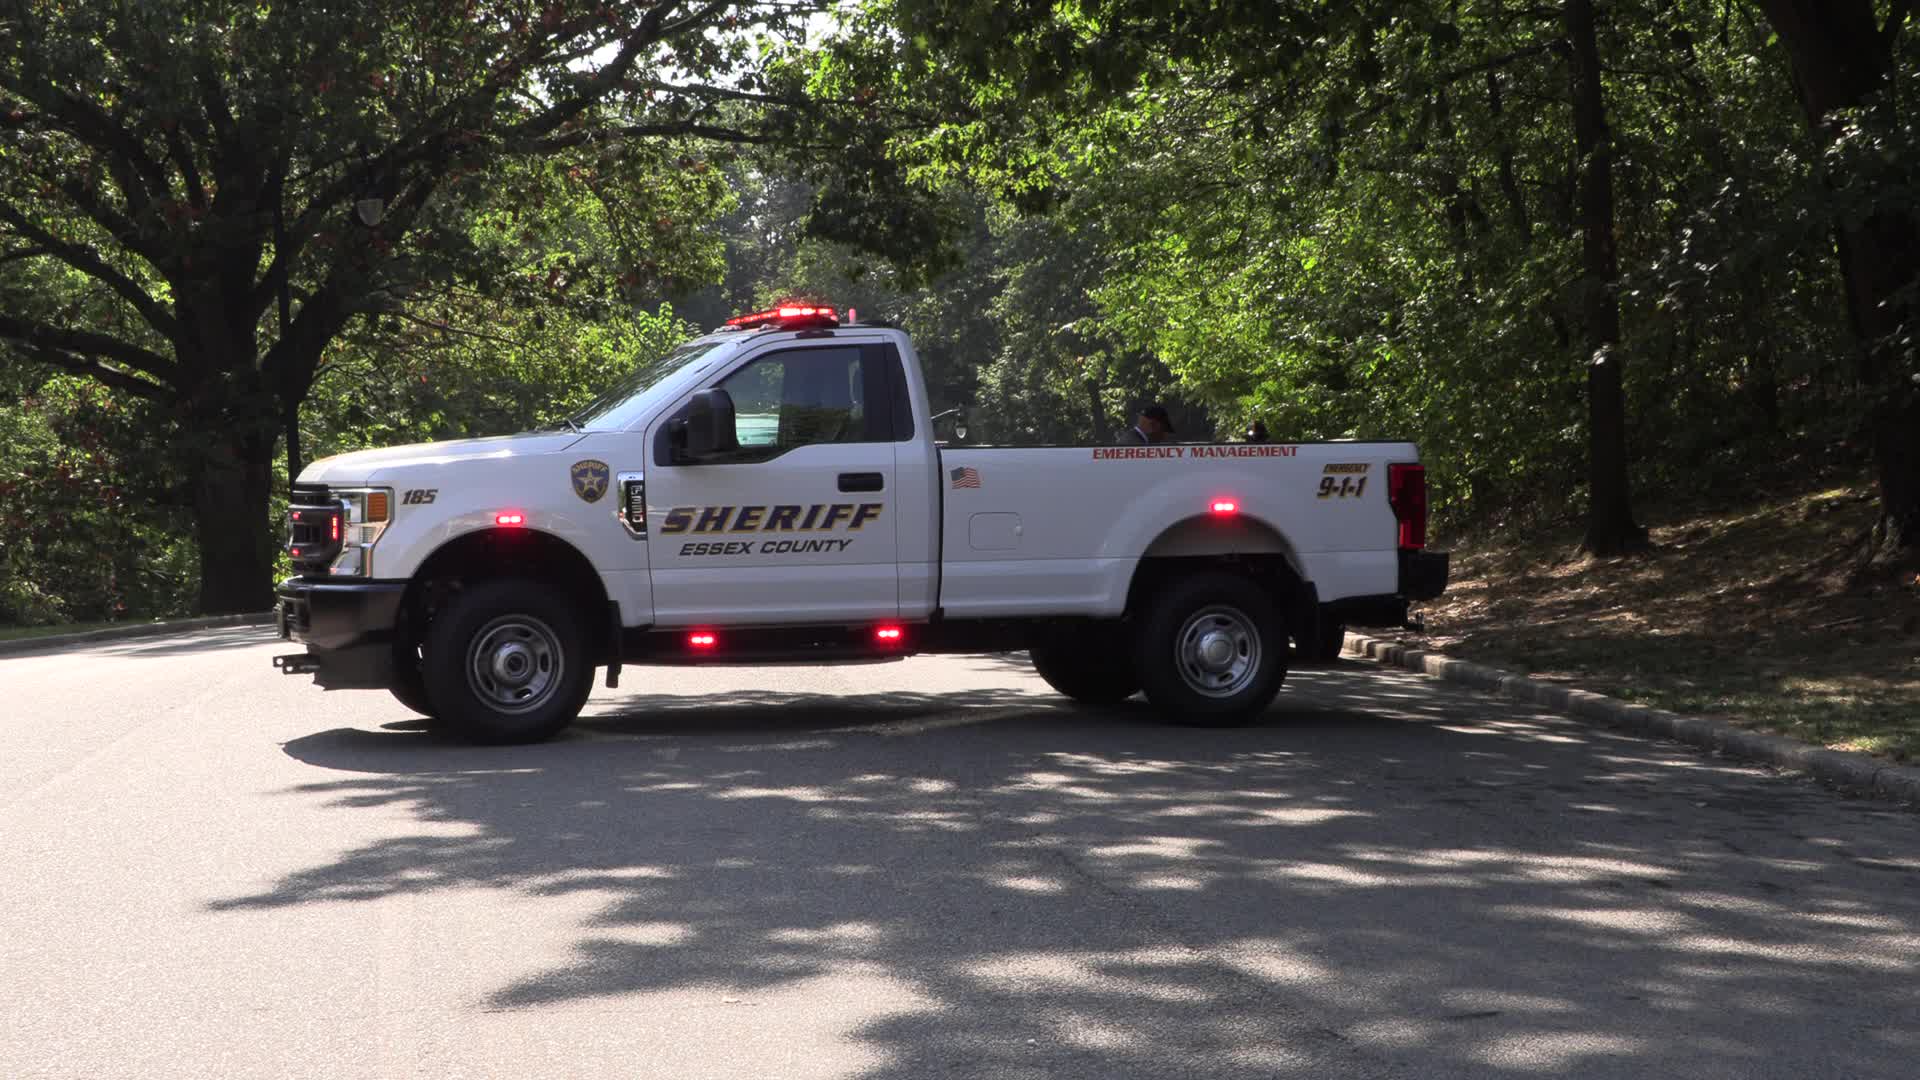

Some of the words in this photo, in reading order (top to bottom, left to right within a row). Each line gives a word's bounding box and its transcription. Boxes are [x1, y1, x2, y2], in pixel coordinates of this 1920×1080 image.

[1093, 448, 1185, 459] EMERGENCY
[1190, 446, 1299, 458] MANAGEMENT
[402, 489, 439, 504] 185
[660, 503, 883, 534] SHERIFF
[679, 541, 754, 556] ESSEX
[760, 538, 854, 554] COUNTY
